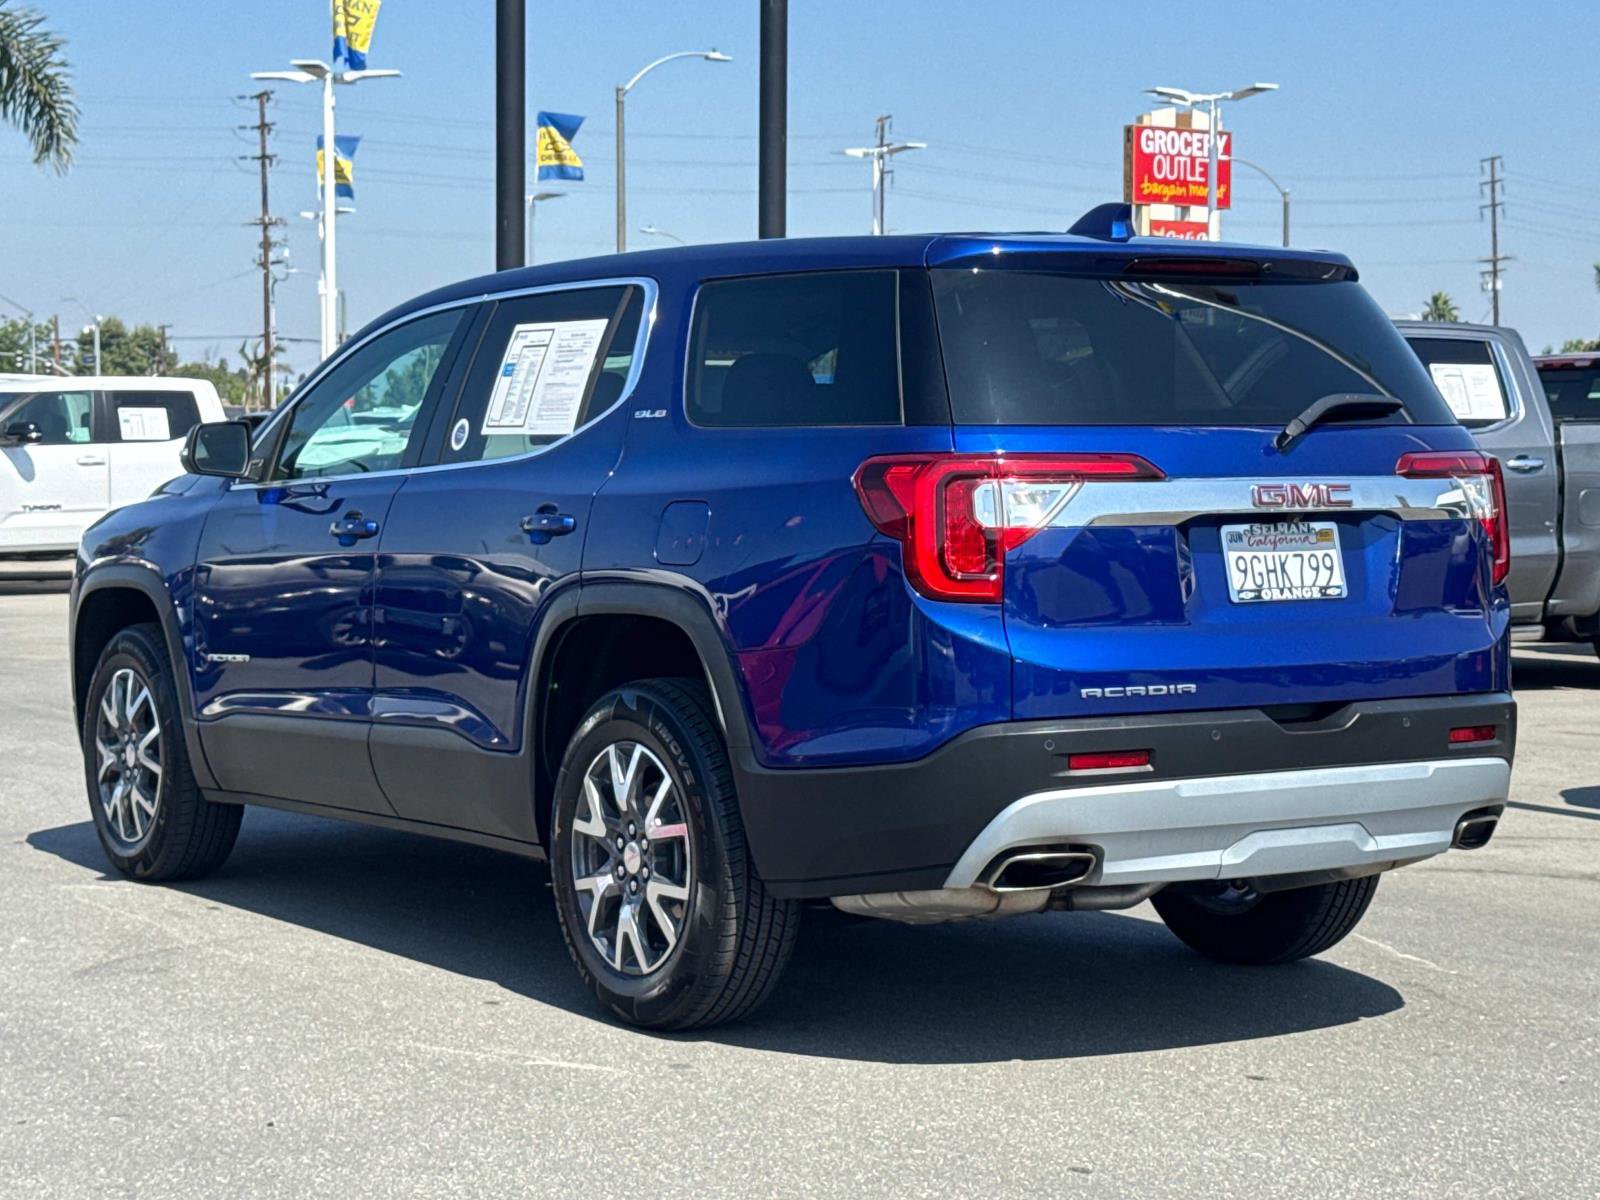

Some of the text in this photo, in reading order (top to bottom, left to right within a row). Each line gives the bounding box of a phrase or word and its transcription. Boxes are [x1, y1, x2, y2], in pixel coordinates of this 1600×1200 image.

[1153, 154, 1210, 182] OUTLE
[1140, 174, 1187, 202] bargain
[1251, 483, 1353, 508] GMC
[1228, 532, 1243, 544] JUN
[1252, 523, 1309, 535] SELMAN
[1247, 533, 1317, 551] California
[1235, 552, 1334, 589] 9GHK799
[1260, 586, 1321, 600] ORANGE
[1080, 683, 1197, 699] ACADIA
